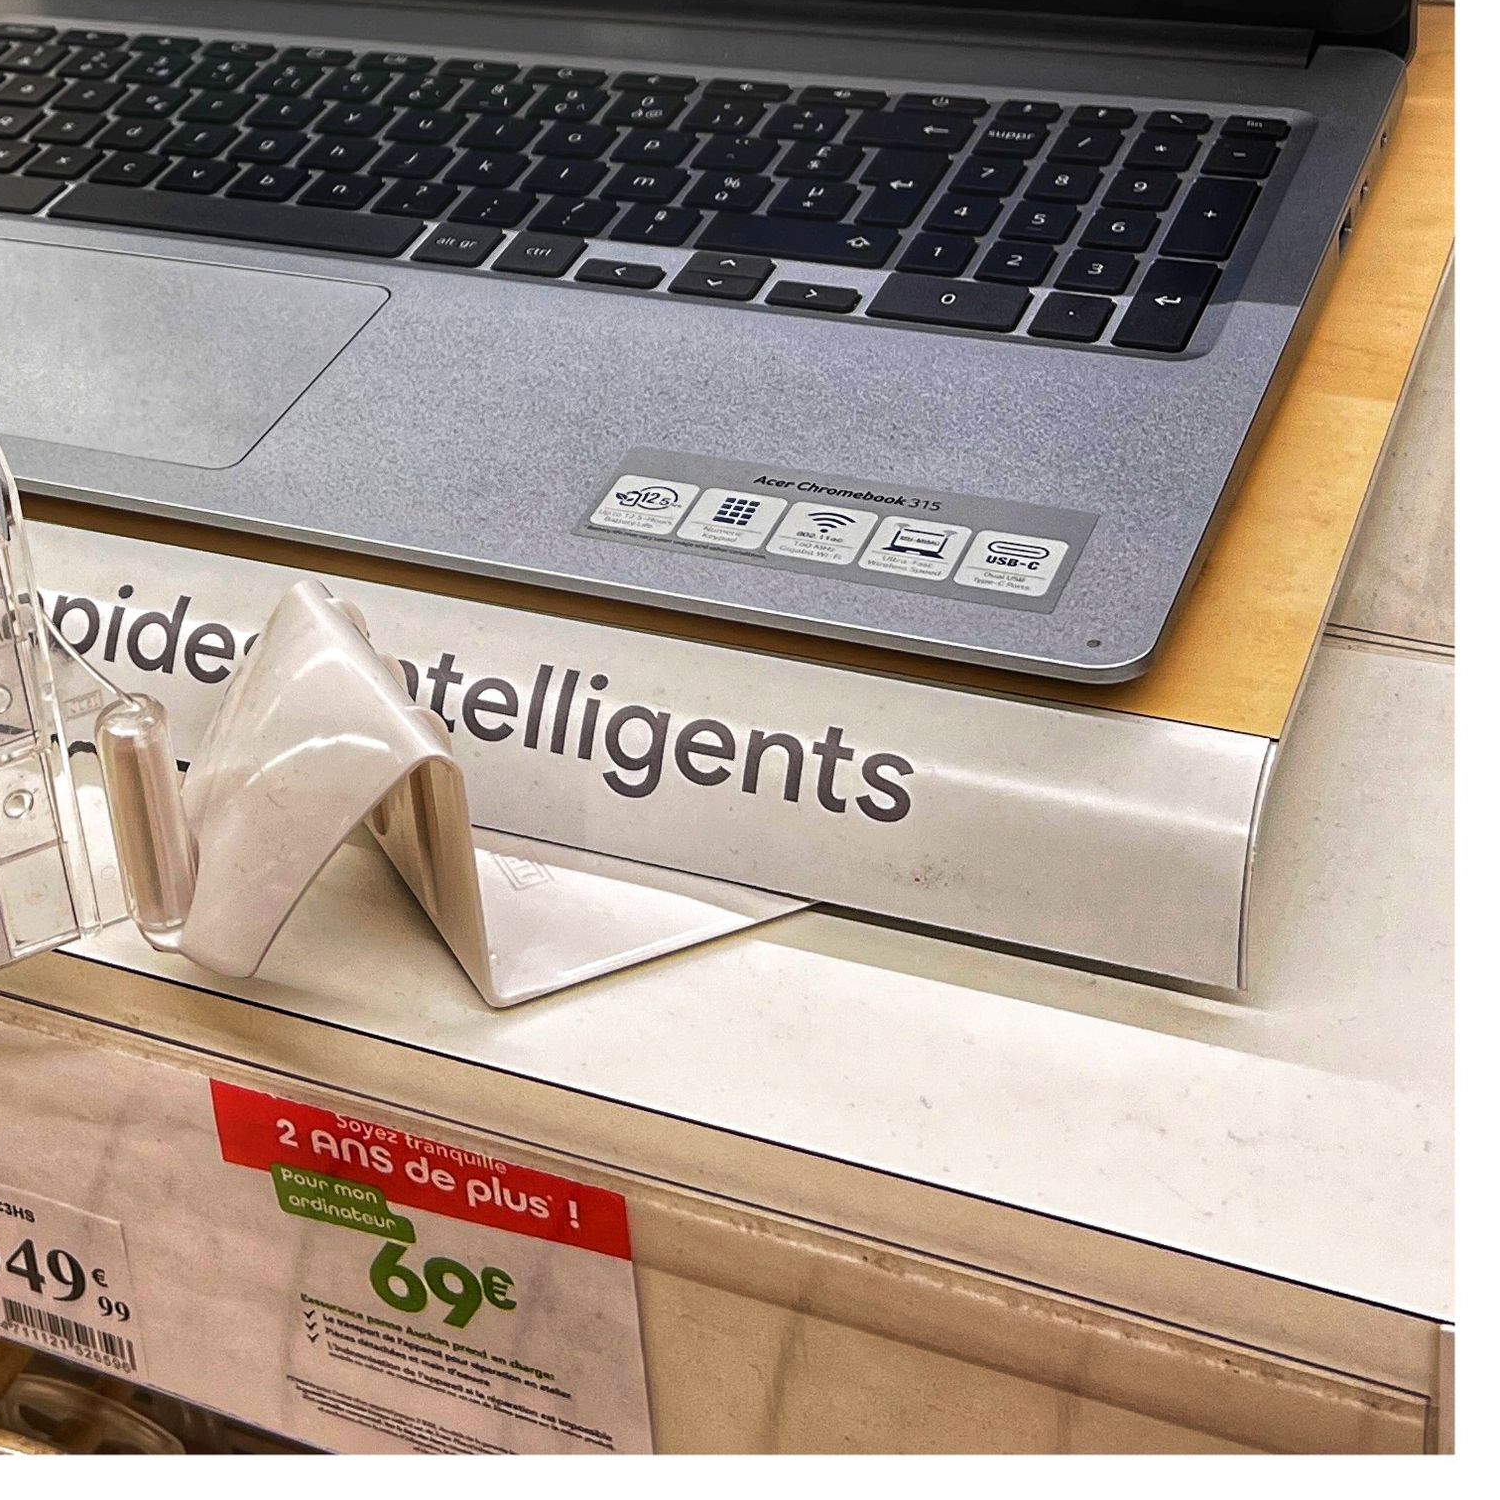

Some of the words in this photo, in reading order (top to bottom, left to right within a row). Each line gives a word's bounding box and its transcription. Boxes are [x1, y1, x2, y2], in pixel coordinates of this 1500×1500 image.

[987, 129, 1037, 143] suppr
[435, 234, 456, 247] alt
[457, 237, 479, 251] gr
[524, 243, 554, 258] ctrl
[752, 474, 795, 491] Acer
[796, 479, 908, 508] Chromebook
[908, 497, 943, 513] 315
[985, 553, 1041, 572] USB-C
[3, 584, 260, 684] pide
[275, 1117, 301, 1150] 2
[404, 1156, 457, 1193] de
[334, 1112, 398, 1147] Soyez
[403, 1132, 509, 1176] tranquille
[287, 1191, 398, 1232] ordinateur
[332, 1182, 380, 1205] mon
[365, 1314, 404, 1334] panne
[405, 1325, 451, 1349] Auchan
[451, 1340, 489, 1362] prend
[489, 1351, 508, 1367] en
